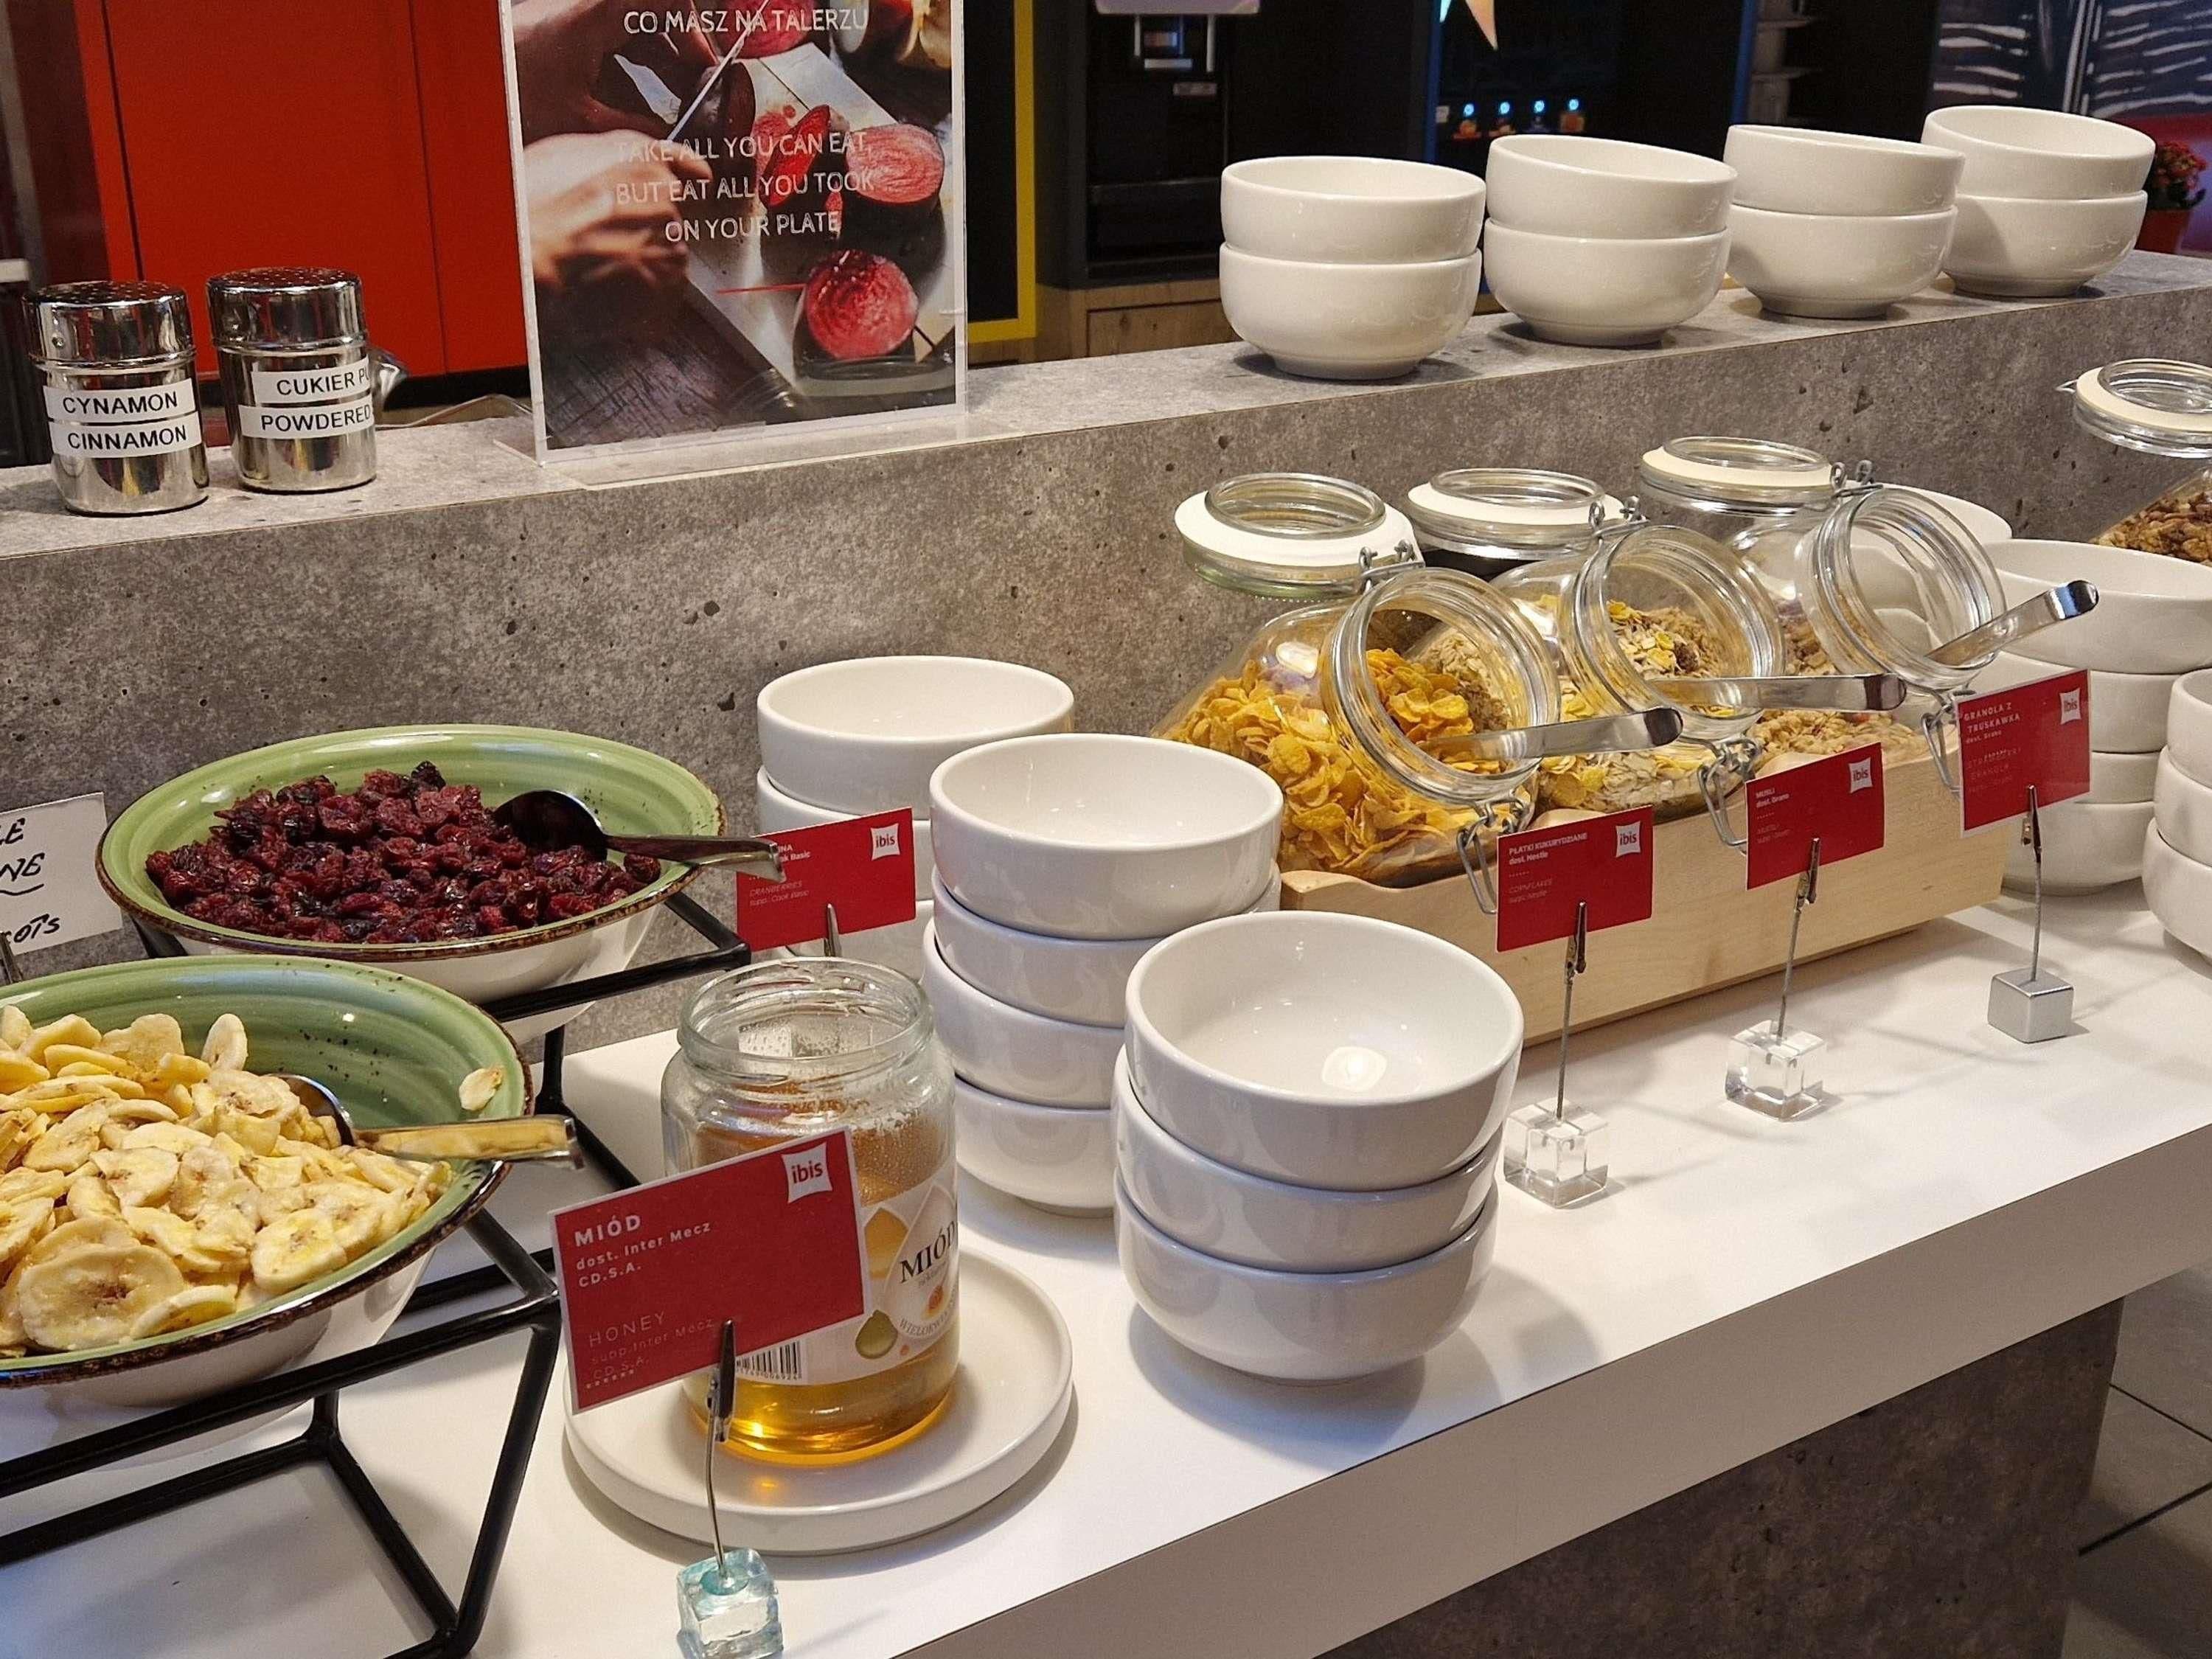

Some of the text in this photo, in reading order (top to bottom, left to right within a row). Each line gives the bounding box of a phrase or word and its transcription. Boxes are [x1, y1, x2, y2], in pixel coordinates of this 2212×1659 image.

[624, 8, 869, 33] CO MASZ NA TALERZU
[618, 139, 674, 162] TAKE
[681, 137, 719, 160] ALL
[724, 136, 774, 158] YOU
[779, 133, 822, 156] CAN
[616, 170, 874, 205] BUT EAT ALL YOU TOOK
[665, 212, 839, 242] ON YOUR PLATE
[276, 372, 355, 395] CUKIER
[63, 392, 178, 414] CYNAMON
[261, 404, 370, 432] POWDERED
[68, 425, 187, 450] CINNAMON
[1964, 703, 2004, 721] GRANOLA
[1967, 713, 2020, 734] TRUSKAWKA
[1853, 768, 1868, 782] ibis
[876, 832, 896, 849] ibis
[1620, 831, 1637, 846] ibis
[791, 1160, 824, 1184] ibis
[574, 1214, 641, 1247] MIÓD
[577, 1222, 711, 1271] dost. Inter Mecz
[578, 1262, 642, 1288] CD.S.A.
[589, 1311, 666, 1348] HONEY
